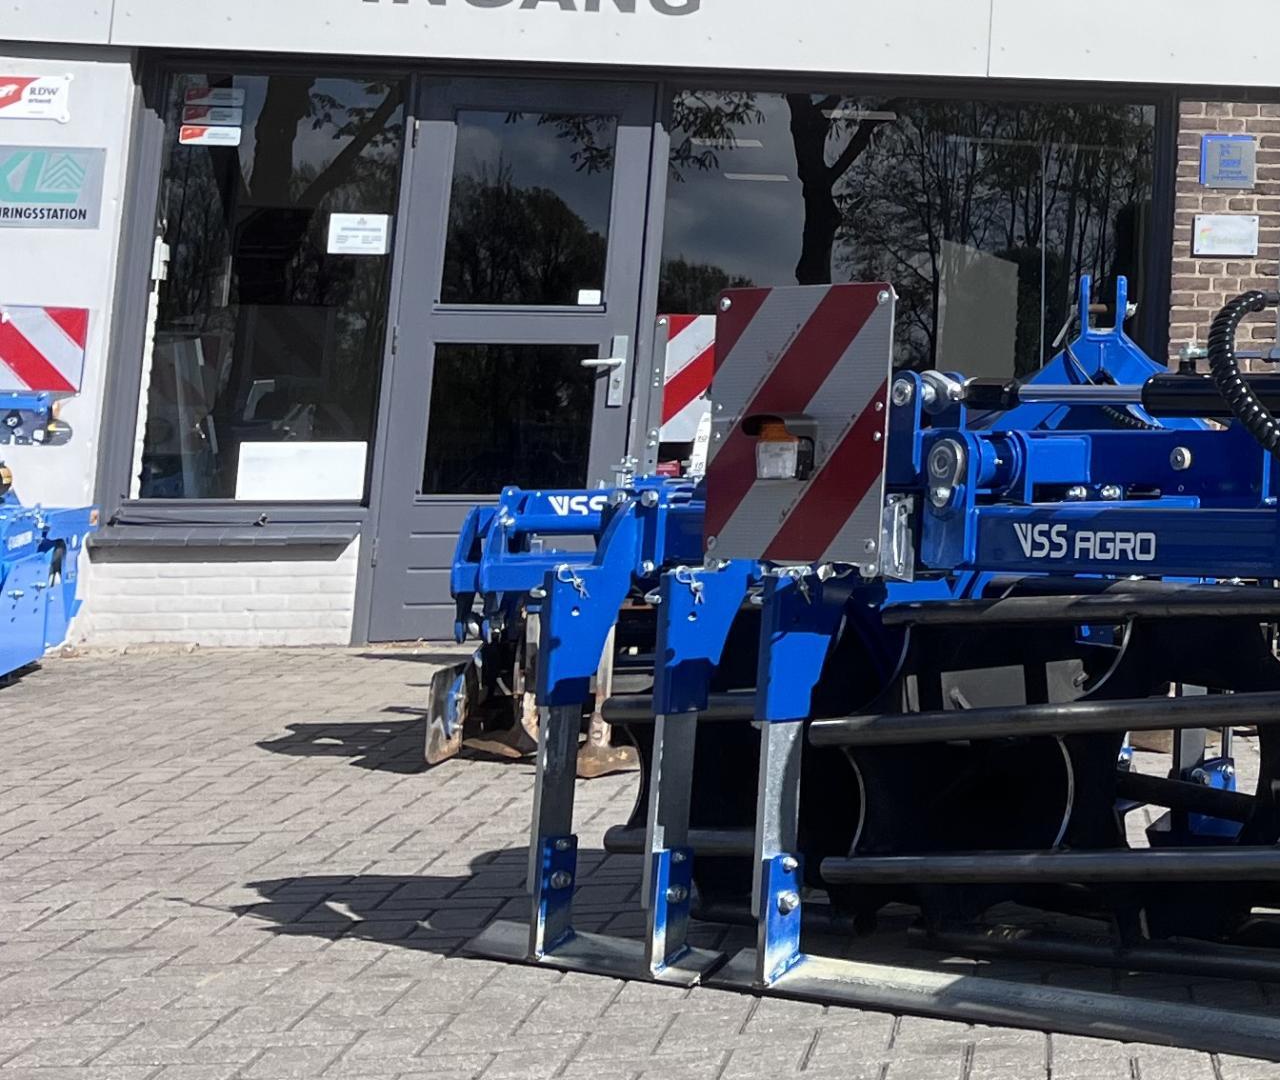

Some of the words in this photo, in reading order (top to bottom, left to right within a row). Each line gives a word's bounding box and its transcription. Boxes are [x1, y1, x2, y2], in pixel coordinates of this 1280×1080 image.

[29, 87, 59, 96] RDW
[548, 495, 608, 517] VSS
[1013, 522, 1068, 559] VSS
[1073, 530, 1157, 561] AGRO
